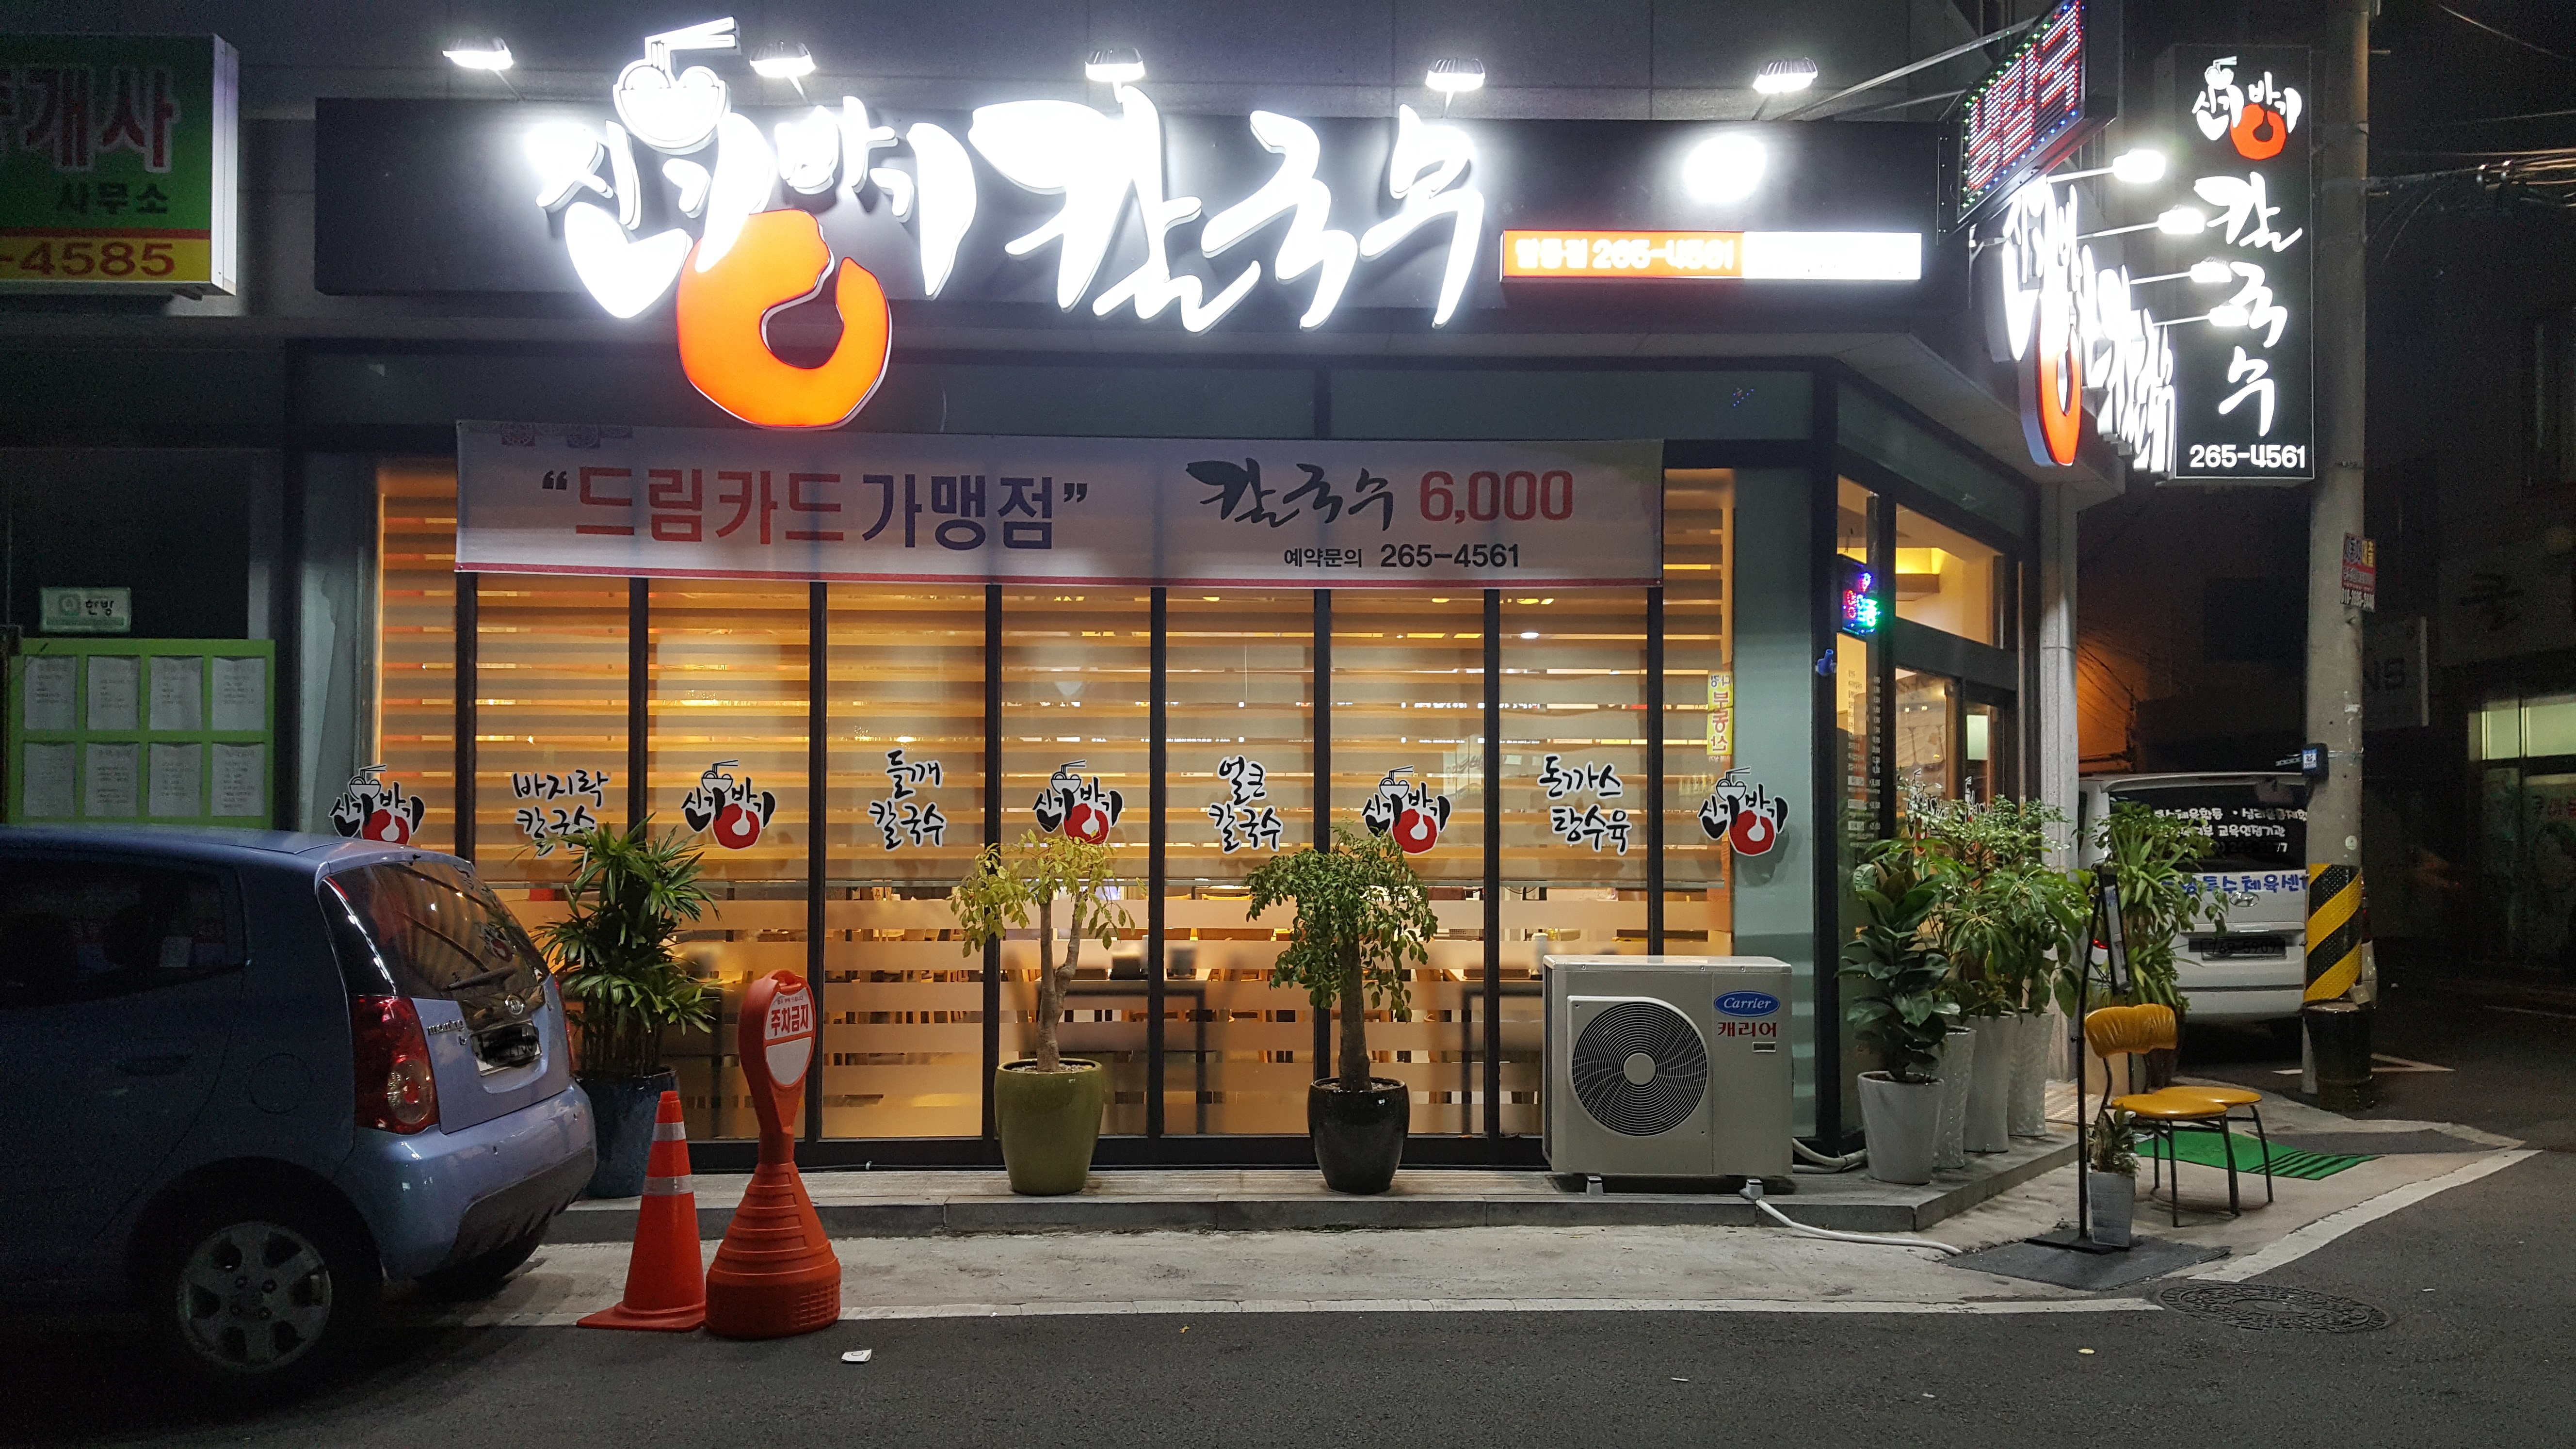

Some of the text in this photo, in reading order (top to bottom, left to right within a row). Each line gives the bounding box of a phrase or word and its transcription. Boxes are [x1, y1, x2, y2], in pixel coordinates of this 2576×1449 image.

[2191, 71, 2302, 161] 신기방기
[56, 182, 169, 215] 사무소
[967, 85, 1485, 334] 칼국수
[2190, 444, 2306, 469] 265-4561
[1186, 457, 1394, 531] 칼국수
[1419, 470, 1574, 525] 6,000
[1283, 543, 1520, 569] 예약문의 265-4561
[513, 769, 609, 807] 바지락
[886, 749, 941, 799] 들깨
[1219, 756, 1266, 805] 얼큰
[1538, 755, 1621, 798] 돈까스
[329, 781, 424, 844] 신기방기
[681, 777, 776, 850] 신기방기
[869, 801, 945, 850] 칼국수
[1032, 777, 1124, 844] 신기방기
[1208, 803, 1282, 852] 칼국수
[1361, 781, 1451, 853] 신기방기
[1552, 804, 1629, 853] 탕수육
[1698, 784, 1788, 856] 신기방기
[2217, 824, 2286, 838] 교육인정기관
[771, 1003, 809, 1036] 주차금지
[1723, 997, 1772, 1010] Carrier
[1718, 1021, 1777, 1038] 캐리어
